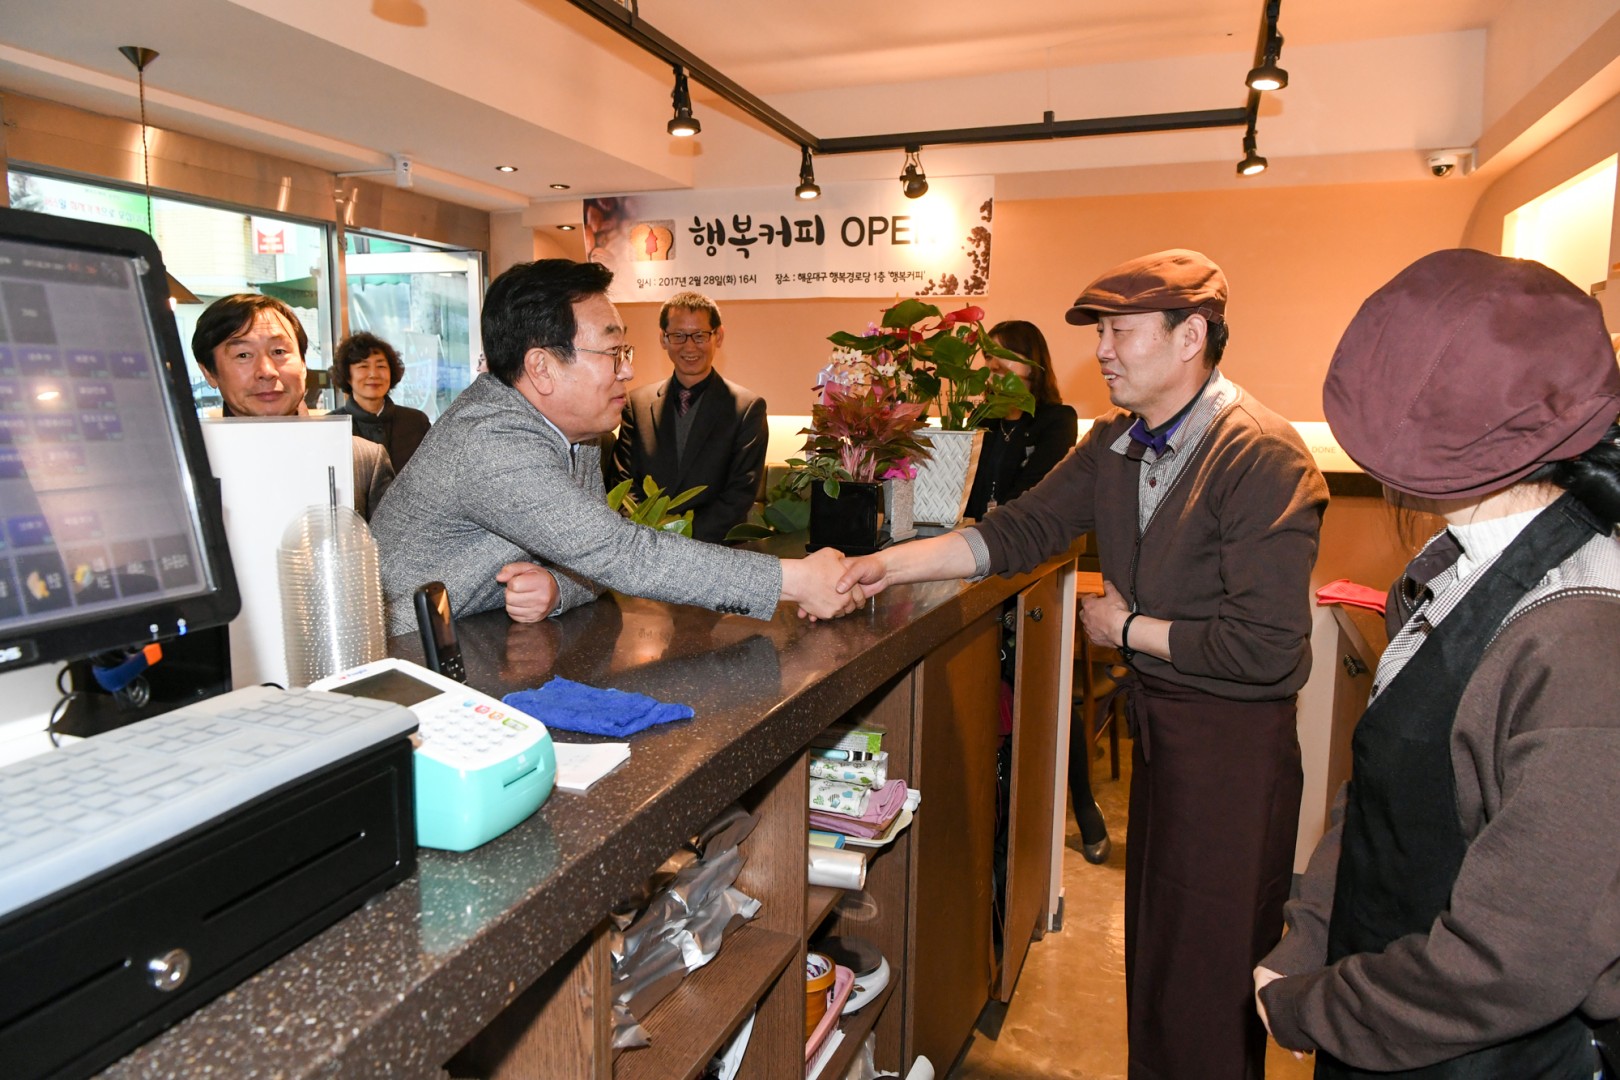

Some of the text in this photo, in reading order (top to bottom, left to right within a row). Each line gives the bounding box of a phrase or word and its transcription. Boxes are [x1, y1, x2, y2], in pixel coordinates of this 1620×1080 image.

[688, 214, 936, 259] 행복커피 OPE
[637, 279, 652, 289] 일시
[658, 275, 687, 288] 2017년
[688, 275, 702, 287] 2월
[703, 274, 737, 287] 28일(화)
[739, 274, 757, 284] 16시
[775, 273, 791, 285] 장소
[797, 272, 828, 284] 해운대구
[829, 271, 871, 284] 행복경로당
[873, 272, 886, 283] 1층
